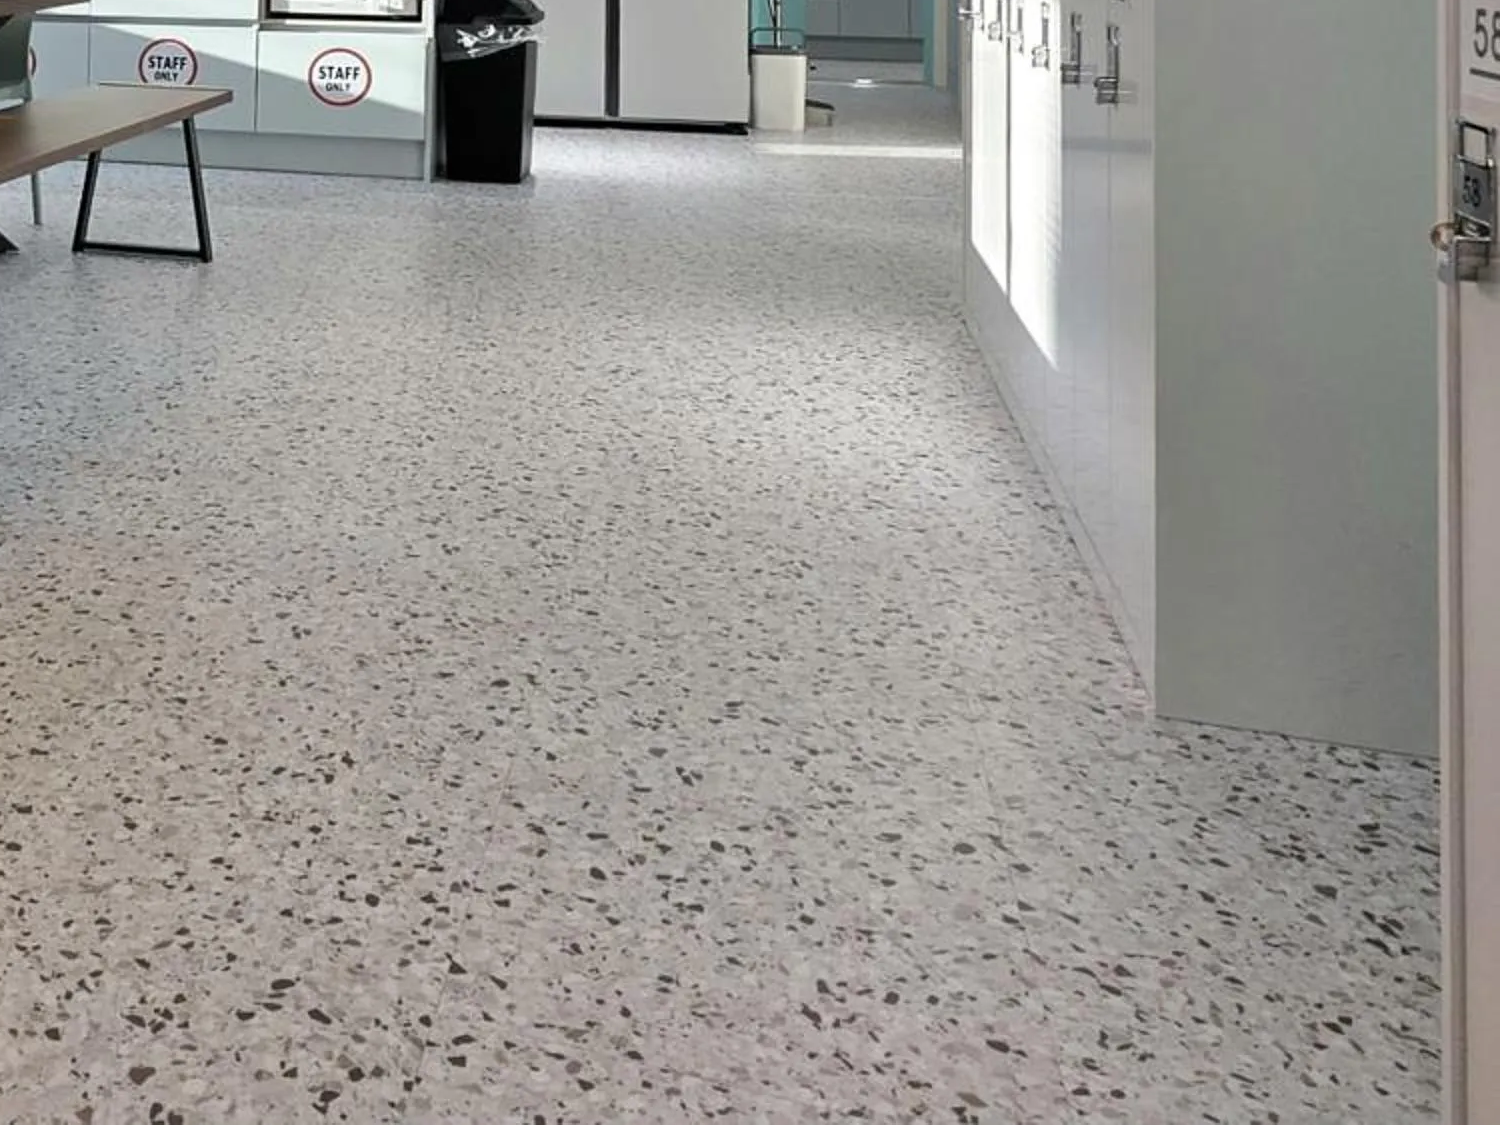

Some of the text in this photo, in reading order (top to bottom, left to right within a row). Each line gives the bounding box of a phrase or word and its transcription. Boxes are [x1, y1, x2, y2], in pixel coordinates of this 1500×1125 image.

[148, 55, 187, 71] STAFF
[154, 70, 179, 82] ONLY
[318, 66, 360, 81] STAFF
[325, 82, 351, 92] ONLY
